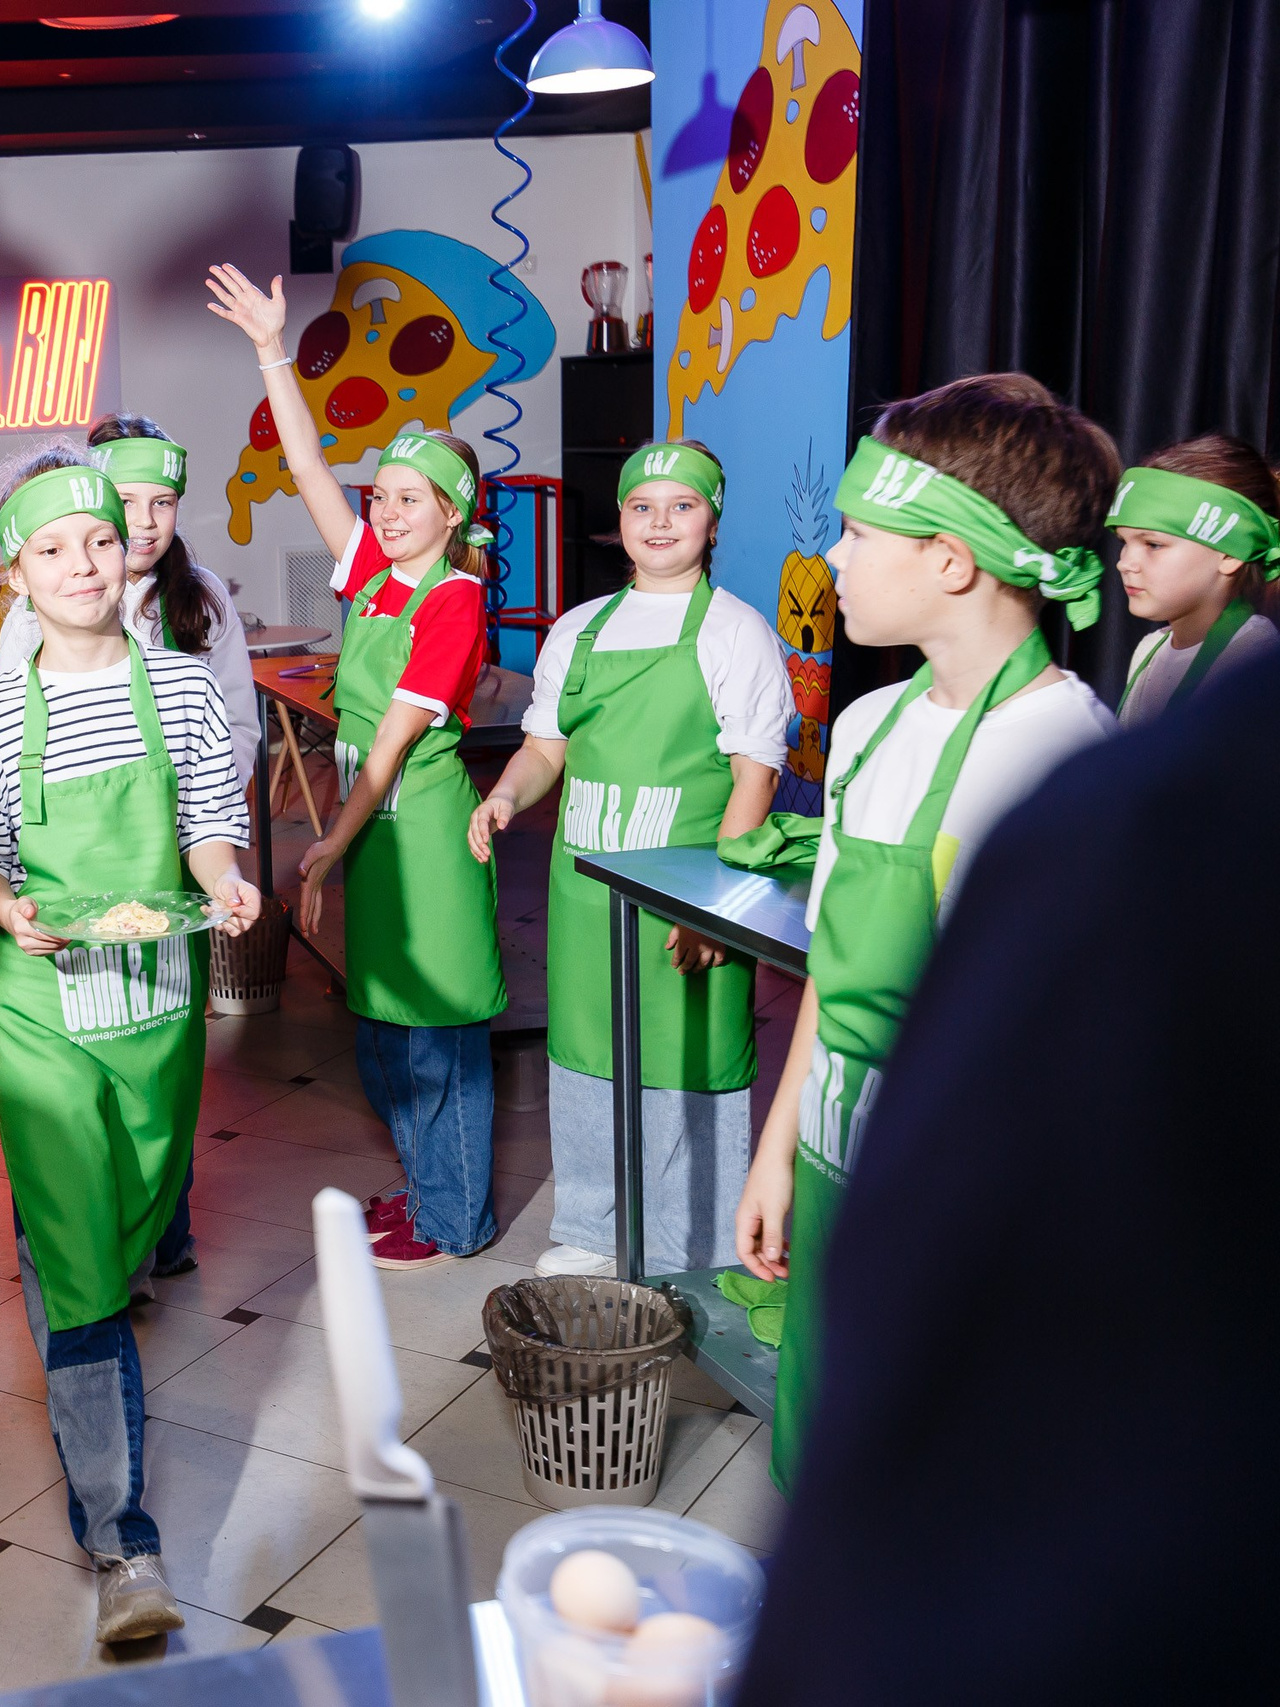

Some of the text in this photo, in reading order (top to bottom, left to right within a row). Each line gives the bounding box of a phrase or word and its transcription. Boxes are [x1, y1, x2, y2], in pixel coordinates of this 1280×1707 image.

[6, 280, 110, 428] RUN
[622, 786, 682, 851] RUN
[54, 944, 130, 1033] COOK
[152, 933, 192, 1017] RUN
[69, 1008, 190, 1046] кулинарное квест-шоу
